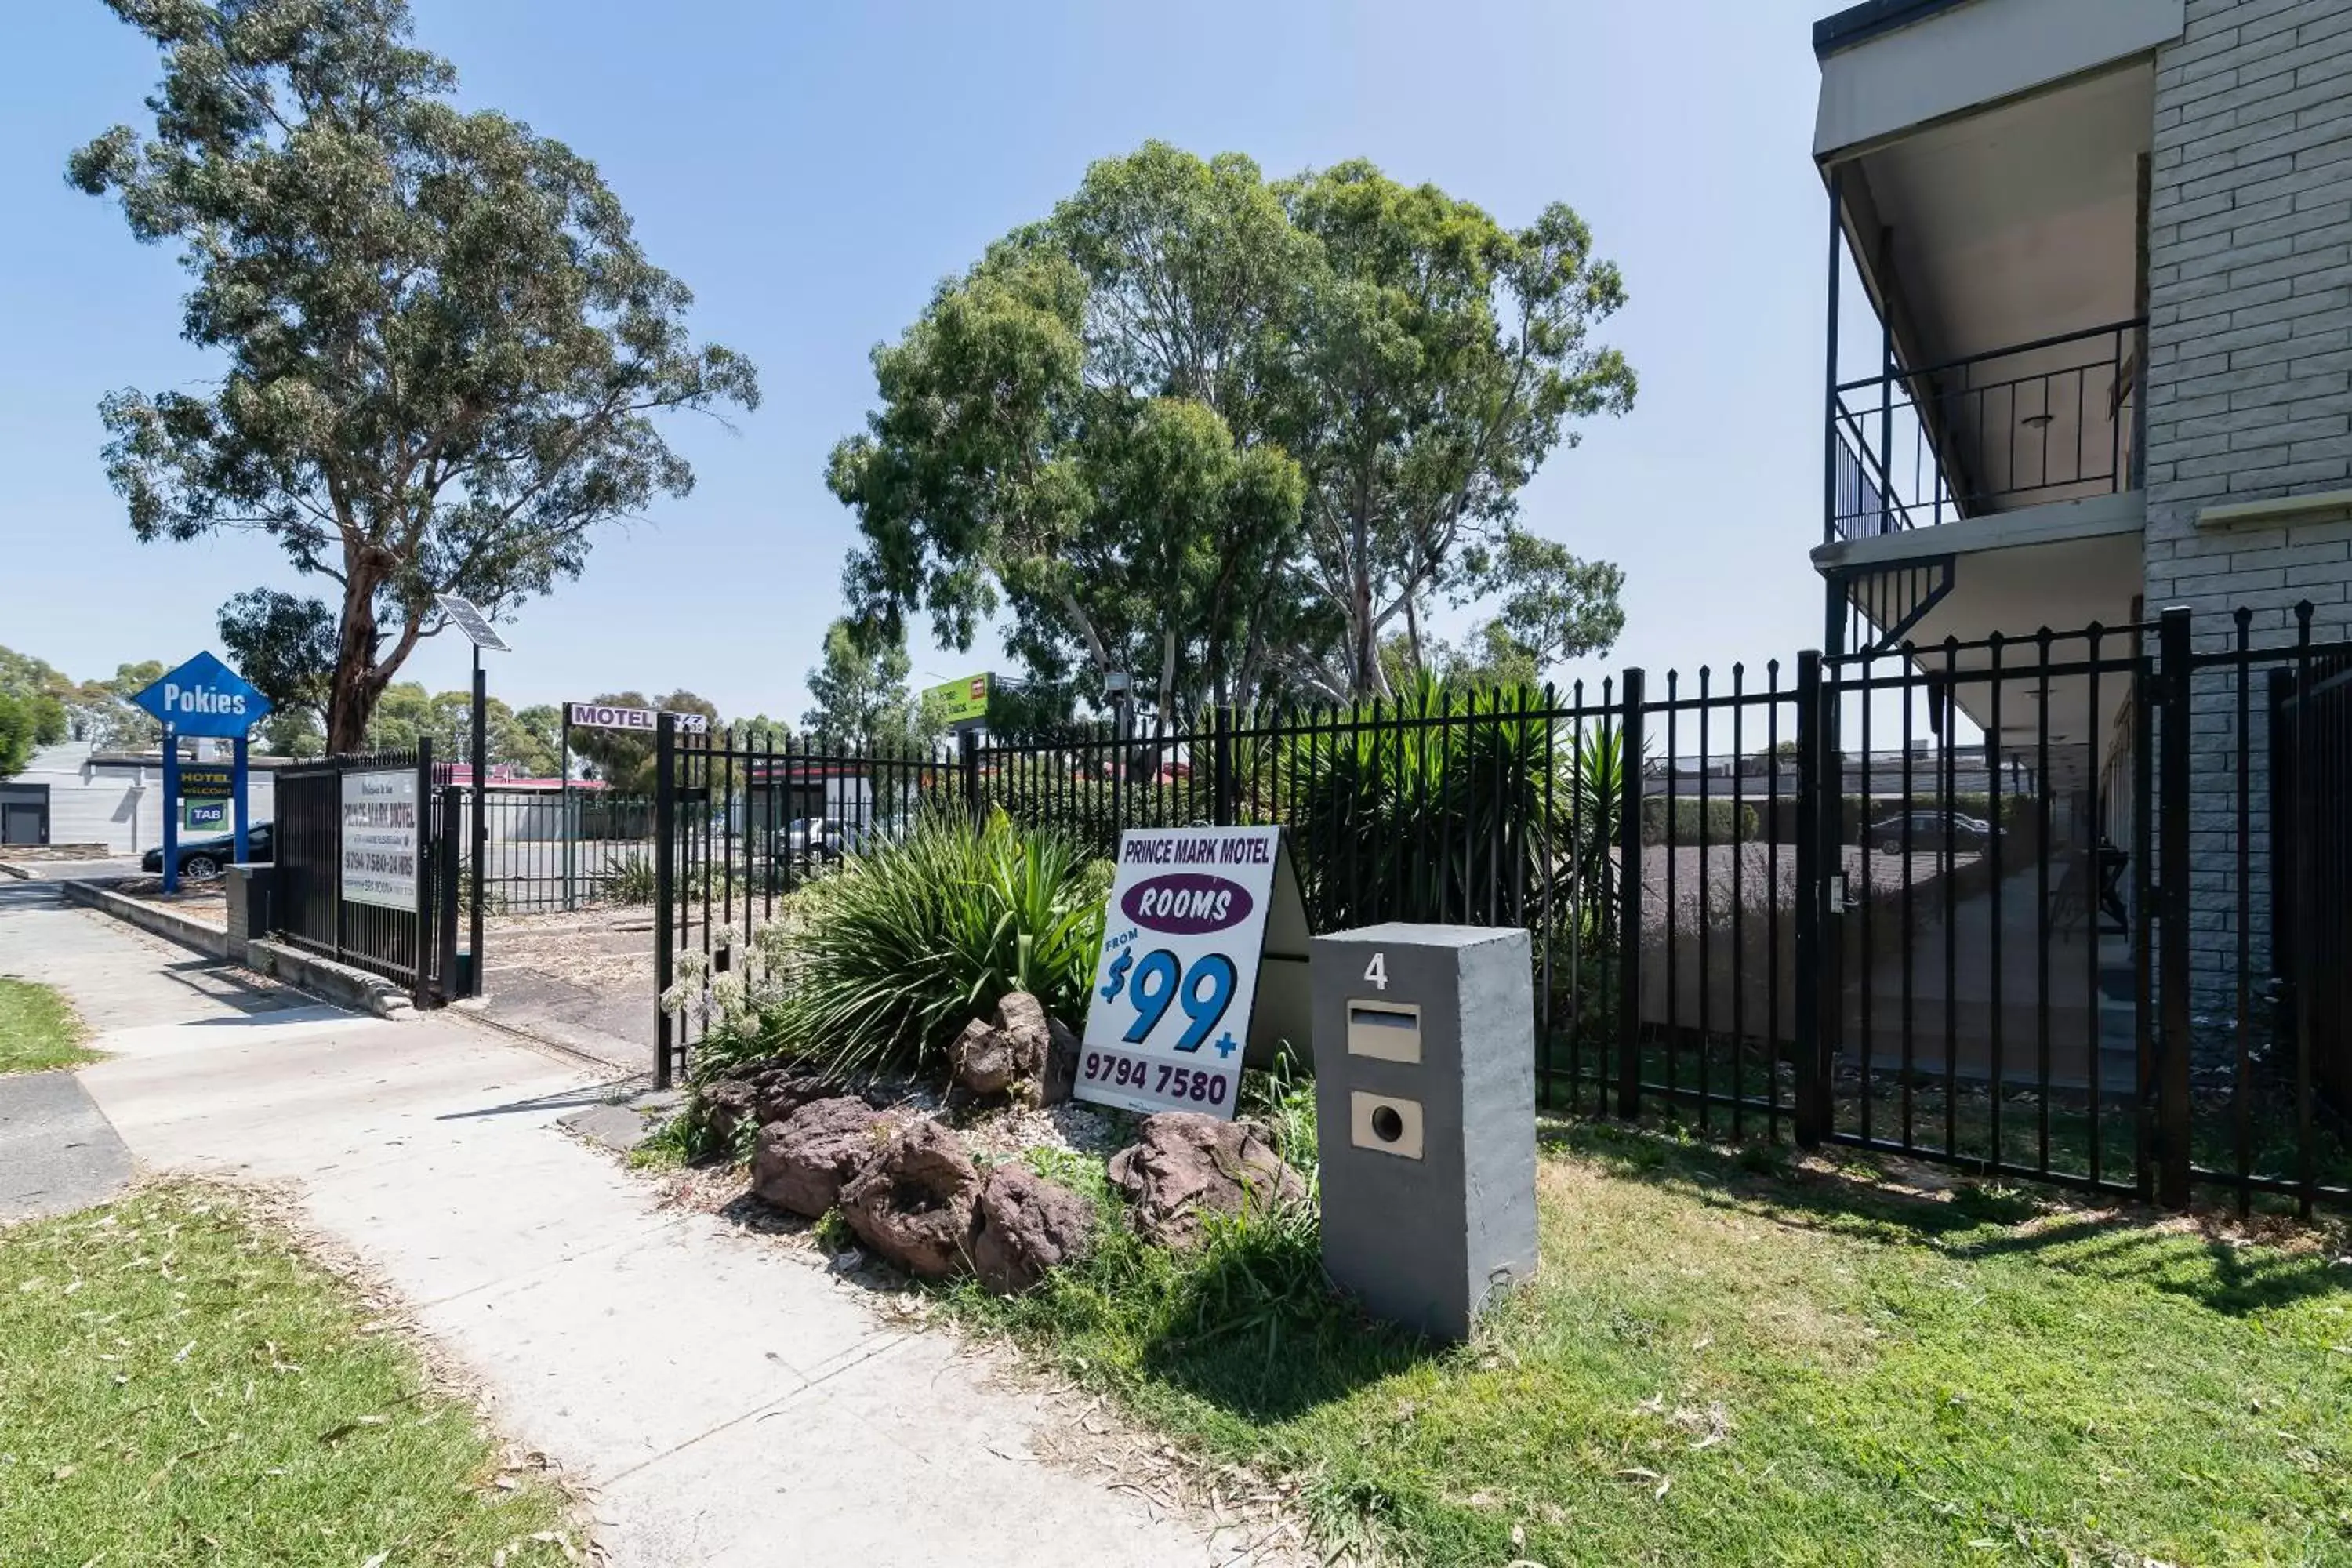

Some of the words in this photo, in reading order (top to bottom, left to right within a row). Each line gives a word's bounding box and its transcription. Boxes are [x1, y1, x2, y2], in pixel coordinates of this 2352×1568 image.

[165, 684, 245, 715] Pokies
[575, 707, 652, 728] MOTEL
[181, 772, 232, 782] HOTEL
[194, 809, 220, 819] TAB
[1124, 840, 1171, 864] PRINCE
[1174, 839, 1218, 864] MARK
[1220, 838, 1269, 864] MOTEL
[1138, 888, 1232, 920] ROOMS
[1105, 928, 1138, 952] FROM
[1363, 953, 1388, 989] 4
[1085, 1053, 1147, 1089] 9794
[1156, 1065, 1227, 1105] 7580
